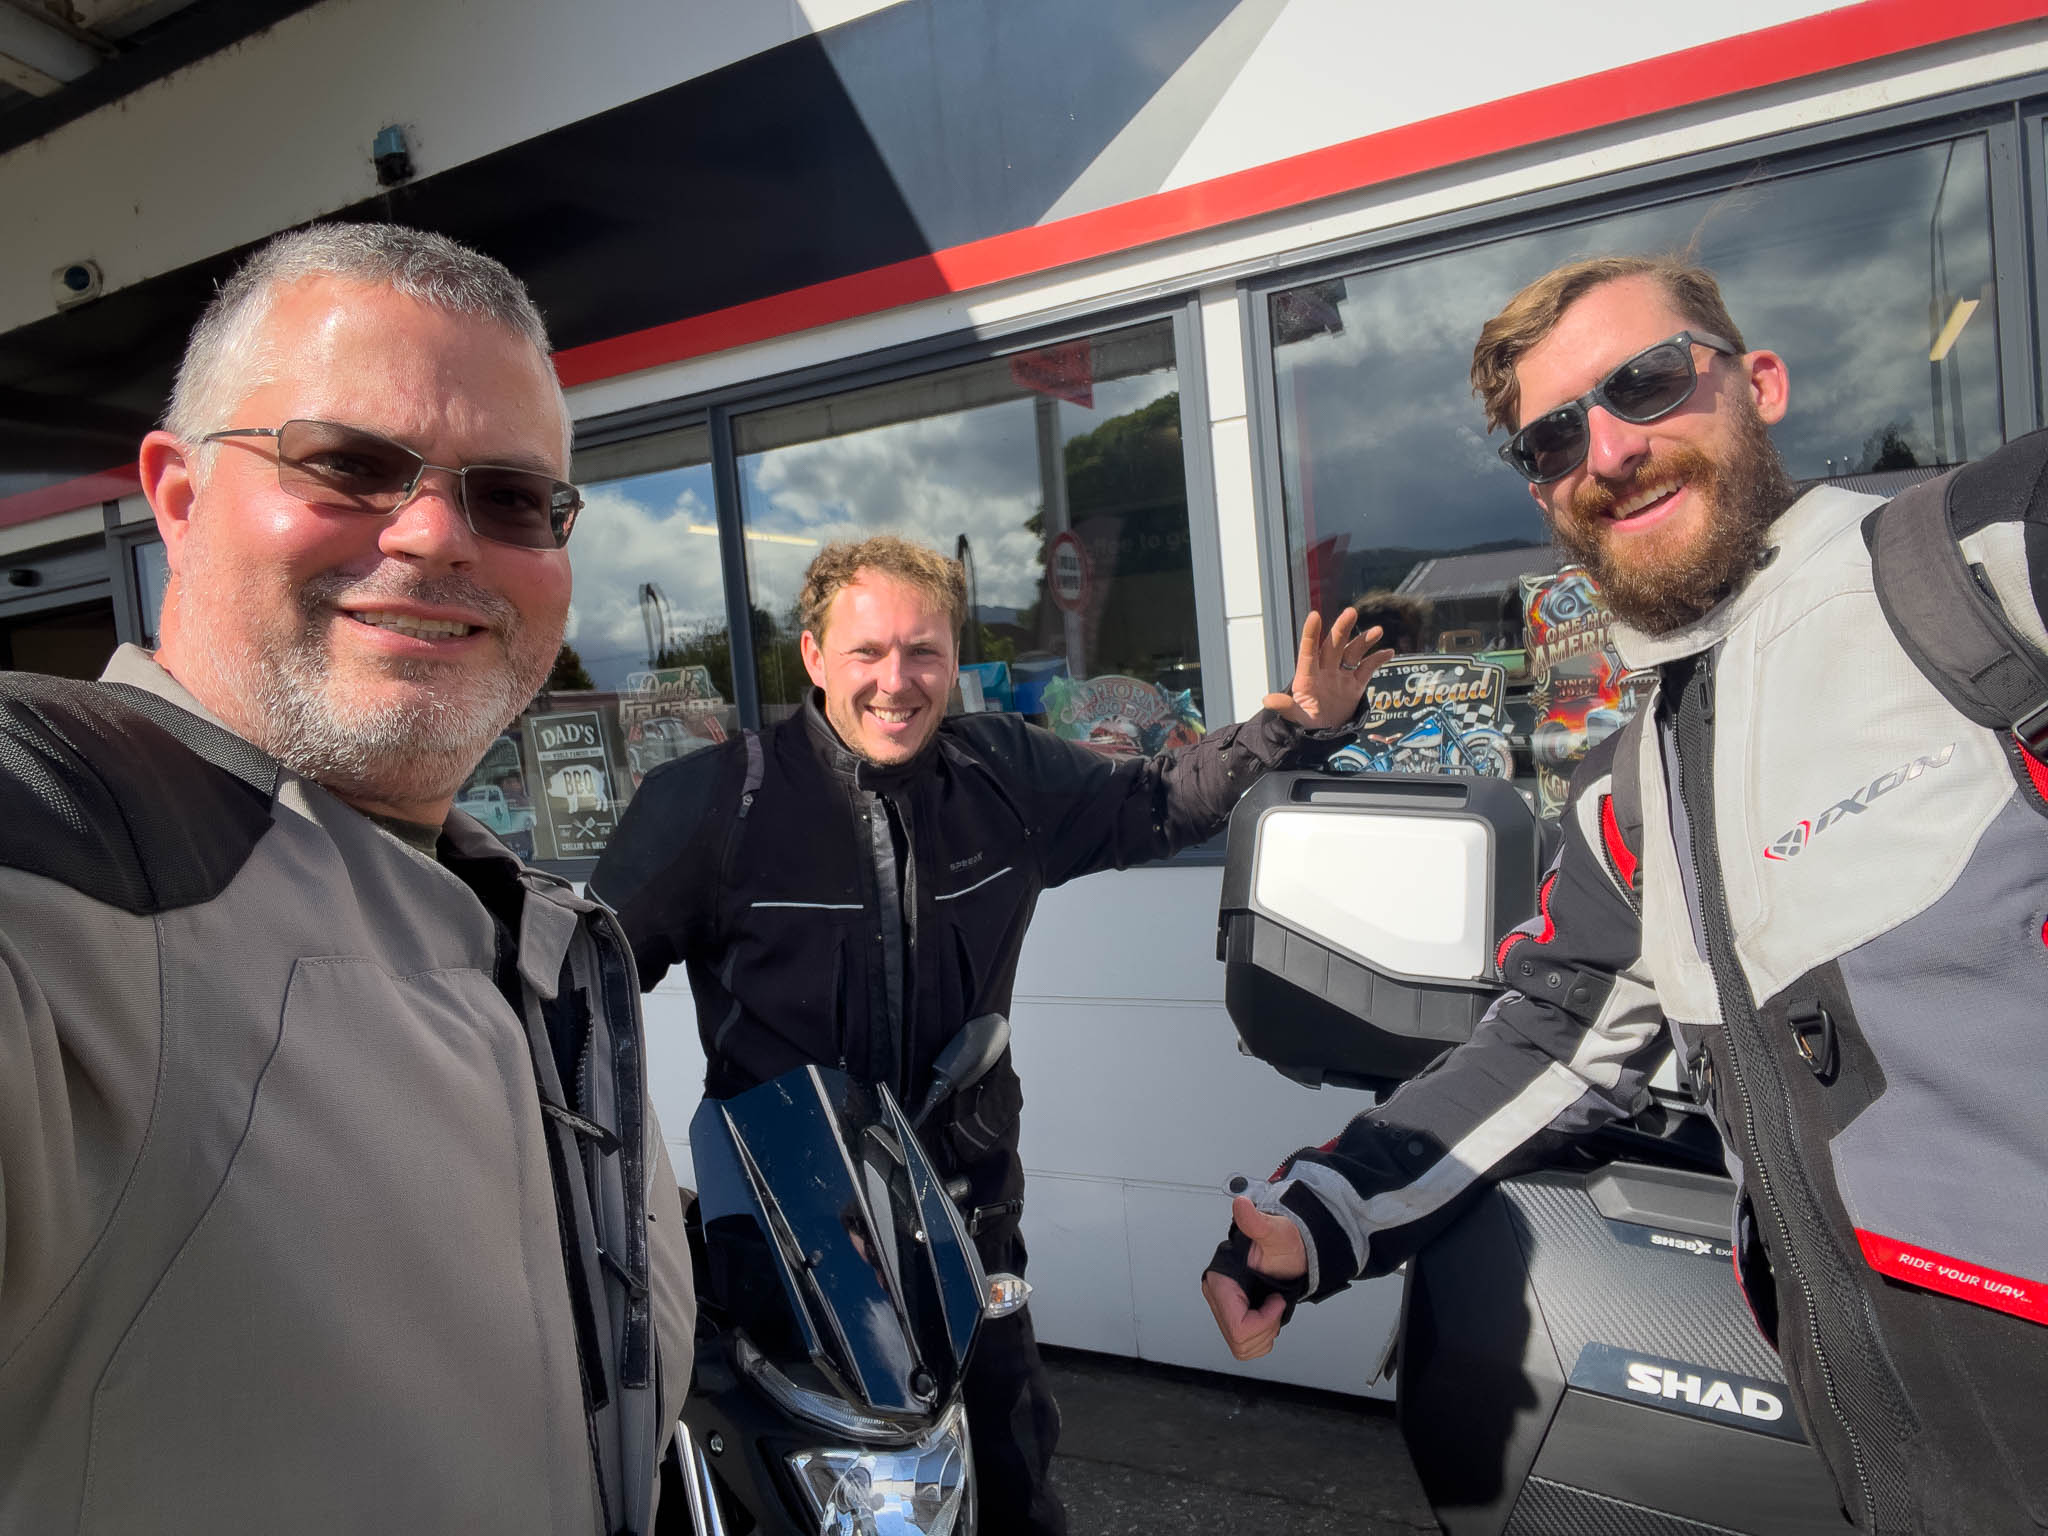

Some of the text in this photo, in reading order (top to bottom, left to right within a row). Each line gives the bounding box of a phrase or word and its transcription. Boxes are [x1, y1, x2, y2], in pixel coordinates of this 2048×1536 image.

[1546, 608, 1614, 643] ONE HO
[1372, 668, 1393, 678] ST.
[1370, 710, 1409, 722] SERVICE
[540, 723, 596, 750] DAD'S
[563, 769, 594, 797] BBQ
[1898, 1253, 1936, 1272] RIDE
[1937, 1265, 1980, 1287] YOUR
[1627, 1363, 1784, 1421] SHAD
